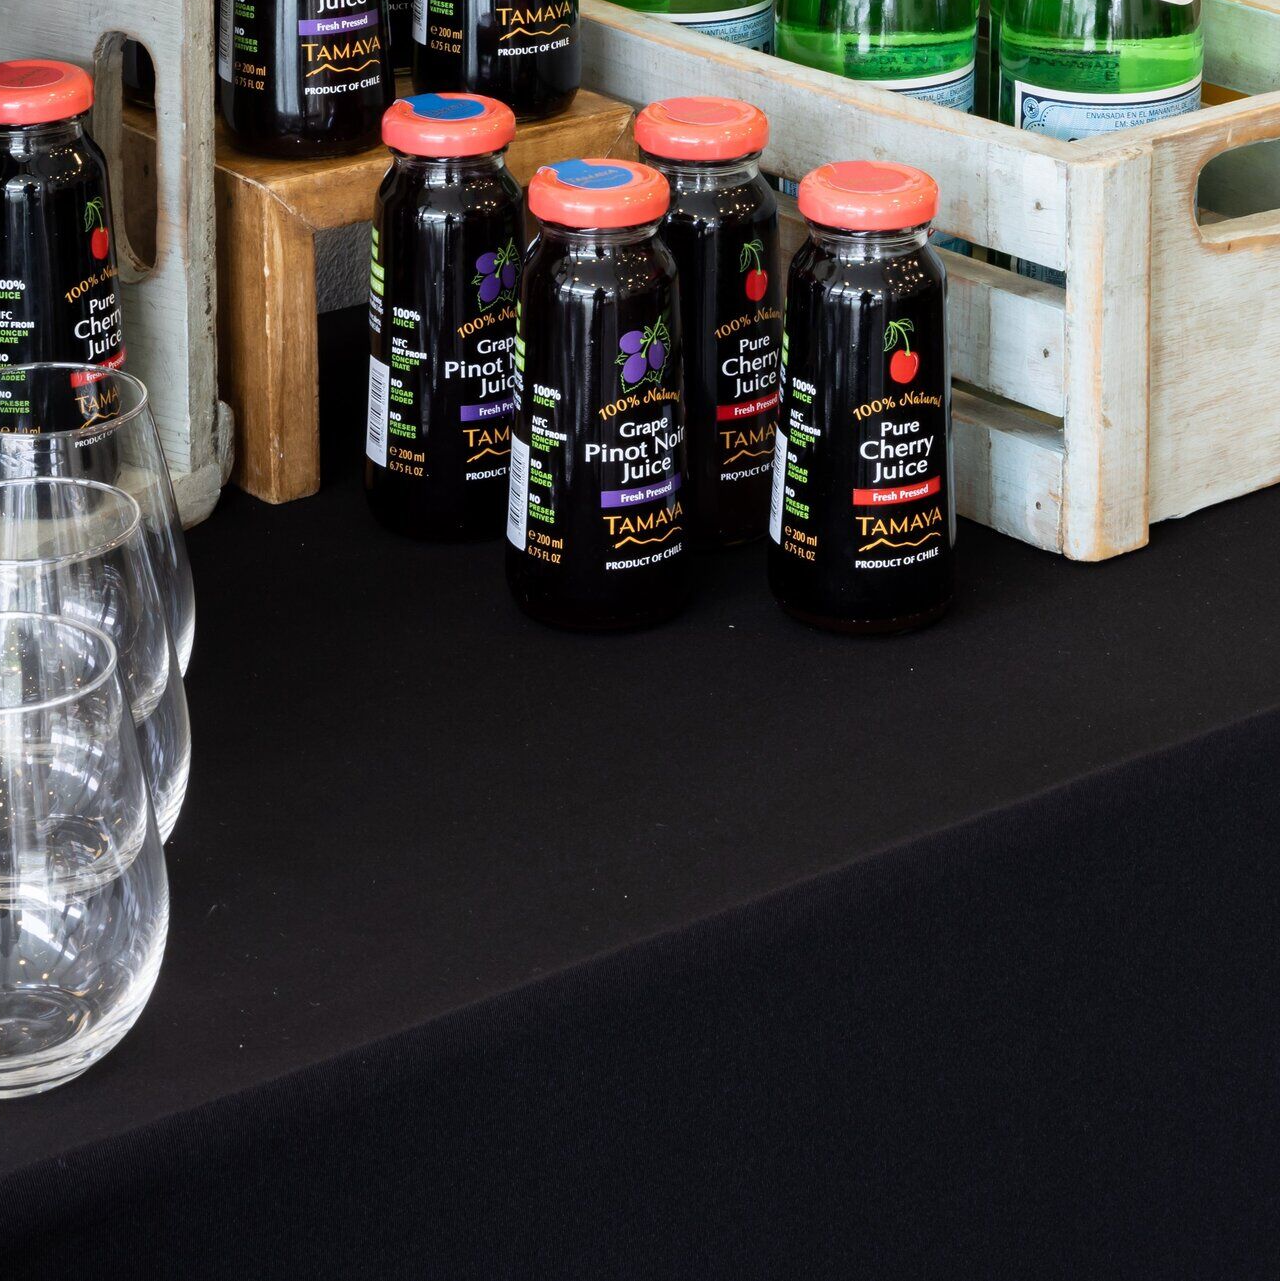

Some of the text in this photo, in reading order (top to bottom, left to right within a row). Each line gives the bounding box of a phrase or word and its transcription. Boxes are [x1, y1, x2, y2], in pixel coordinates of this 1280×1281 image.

[496, 1, 571, 25] TAMAYA
[317, 15, 368, 32] Fresh Pressed
[301, 36, 381, 62] TAMAYA
[498, 37, 569, 56] PRODUCT OF CHILE
[305, 75, 380, 95] PRODUCT OF CHILE
[1086, 111, 1125, 119] ENVASADA
[1127, 110, 1137, 118] EN
[1139, 110, 1147, 118] EL
[1130, 119, 1144, 127] SAN
[65, 274, 99, 303] 100%
[89, 293, 115, 314] Pure
[393, 307, 420, 321] 100%
[393, 317, 414, 329] JUICE
[11, 321, 34, 329] FROM
[457, 314, 495, 338] 100%
[714, 314, 751, 339] 100%
[88, 329, 122, 360] Juice
[739, 335, 770, 353] Pure
[445, 357, 503, 379] Pinot
[722, 347, 779, 377] Cherry
[533, 384, 561, 401] 100%
[734, 370, 777, 399] Juice
[793, 378, 816, 396] 100%
[533, 395, 555, 408] JUICE
[598, 387, 680, 420] 100% Natural
[734, 394, 777, 416] Fresh Pressed
[793, 390, 812, 404] JUICE
[853, 391, 942, 420] 100% Natural
[479, 403, 500, 416] Fresh
[532, 416, 548, 428] NFC
[620, 417, 668, 438] Grape
[881, 421, 920, 437] Pure
[74, 434, 105, 449] PRODUCT
[532, 425, 567, 441] NOT FROM
[532, 433, 559, 447] CONCEN
[532, 441, 550, 452] TRATE
[585, 425, 685, 462] Pinot Noir
[860, 435, 934, 460] Cherry
[531, 459, 542, 469] NO
[621, 457, 671, 484] Juice
[721, 463, 771, 481] PRODUCT OF
[873, 460, 928, 483] Juice
[530, 476, 552, 488] ADDED
[531, 468, 553, 481] SUGAR
[529, 493, 540, 503] NO
[621, 483, 672, 503] Fresh Pressed
[873, 485, 929, 502] Fresh Pressed
[529, 502, 554, 517] PRESER
[529, 510, 554, 524] VATIVES
[603, 501, 683, 535] TAMAYA
[856, 506, 942, 536] TAMAYA
[537, 534, 563, 549] 200 ml
[528, 545, 561, 564] 6.75 FL OZ
[606, 542, 682, 570] PRODUCT OF CHILE
[855, 546, 939, 569] PRODUCT OF CHILE
